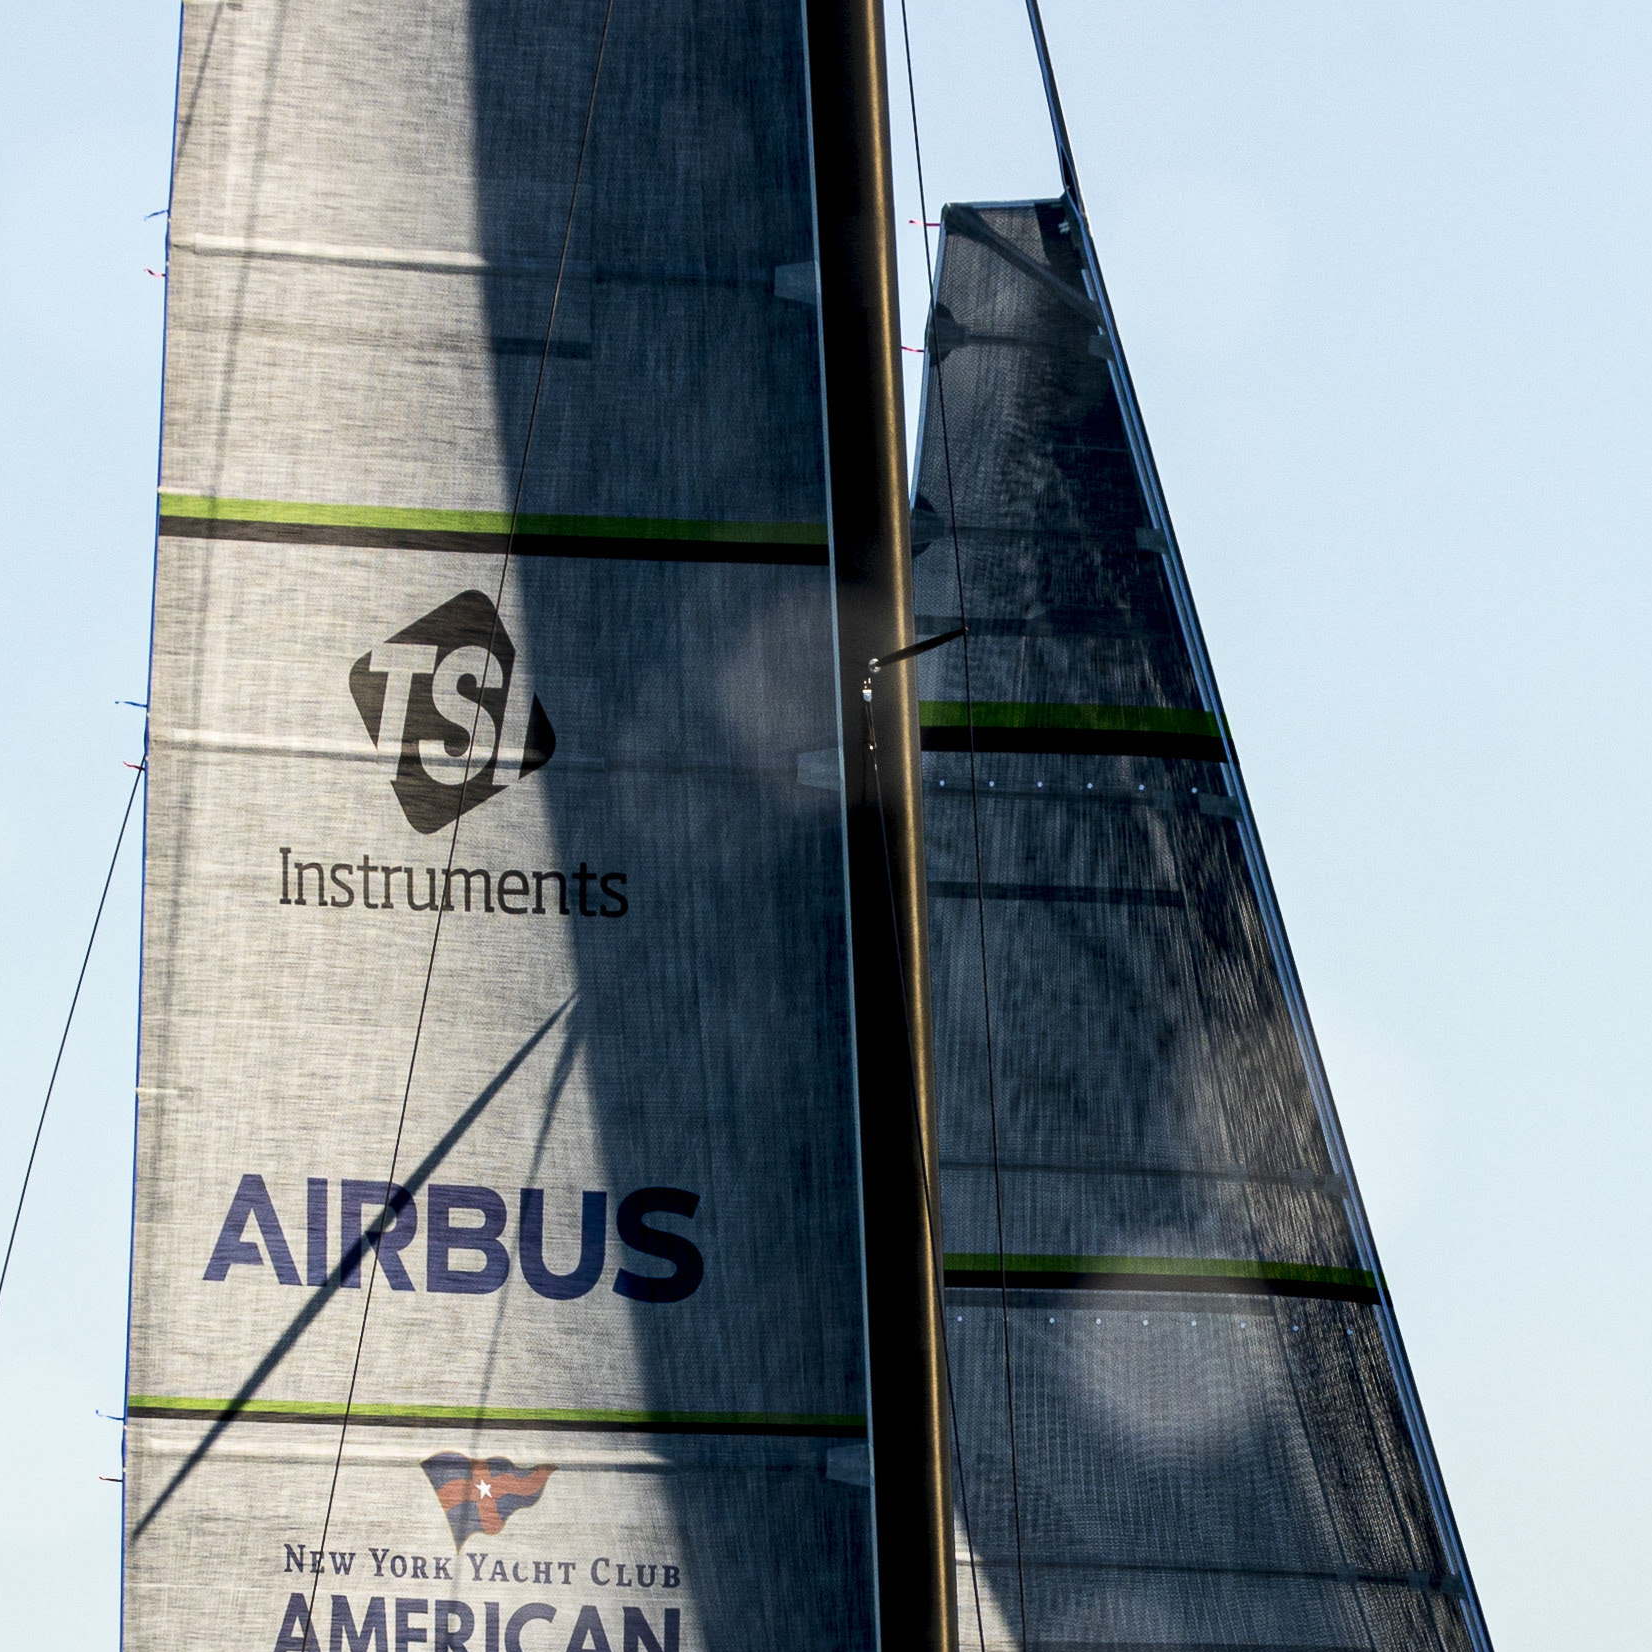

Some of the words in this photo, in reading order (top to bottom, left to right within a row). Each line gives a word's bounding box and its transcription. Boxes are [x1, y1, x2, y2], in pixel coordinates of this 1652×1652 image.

[367, 642, 537, 787] TSI
[279, 846, 629, 918] Instruments
[202, 1173, 704, 1304] AIRBUS
[284, 1543, 355, 1577] NEW
[369, 1548, 452, 1581] YORK
[590, 1557, 682, 1589] CLUB
